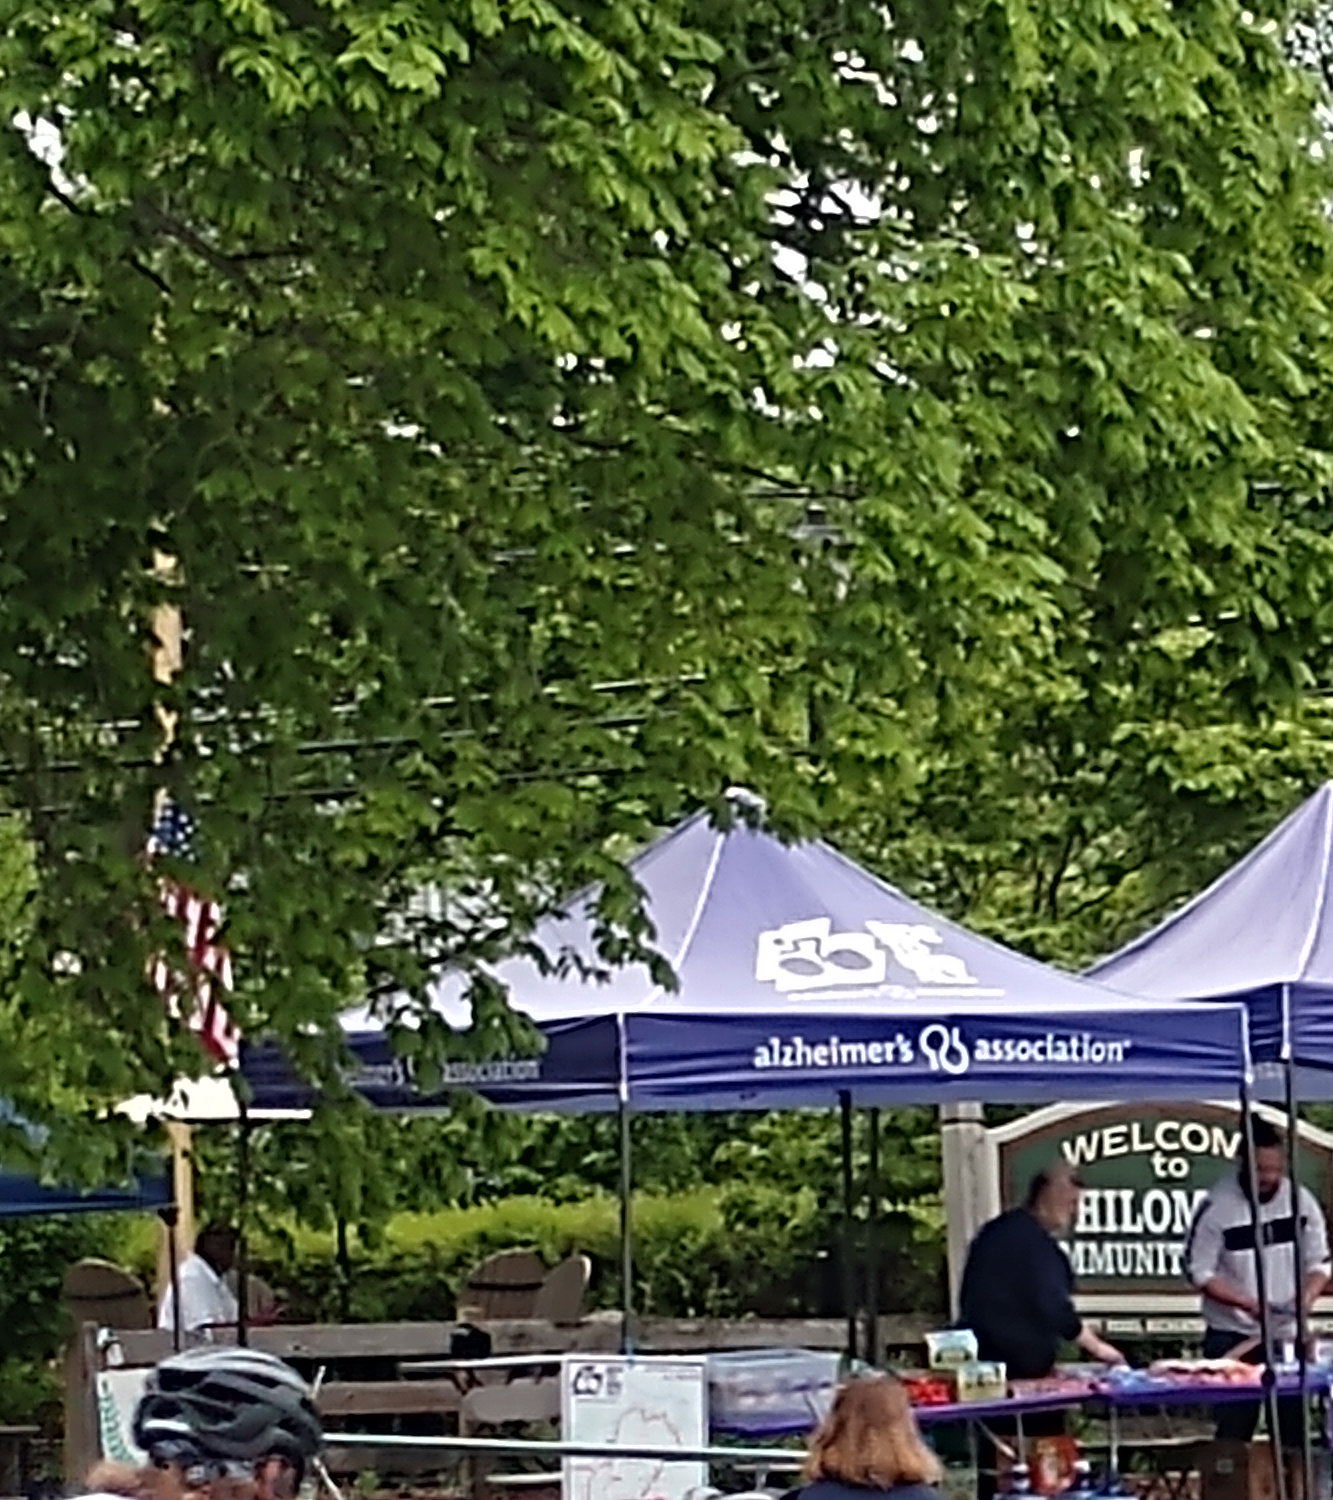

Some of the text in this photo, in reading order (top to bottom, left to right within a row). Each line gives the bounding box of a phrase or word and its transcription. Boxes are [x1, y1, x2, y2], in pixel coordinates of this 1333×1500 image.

[753, 1033, 1124, 1068] alzheimer's association
[1062, 1121, 1242, 1166] WELCOM
[1151, 1151, 1189, 1178] to
